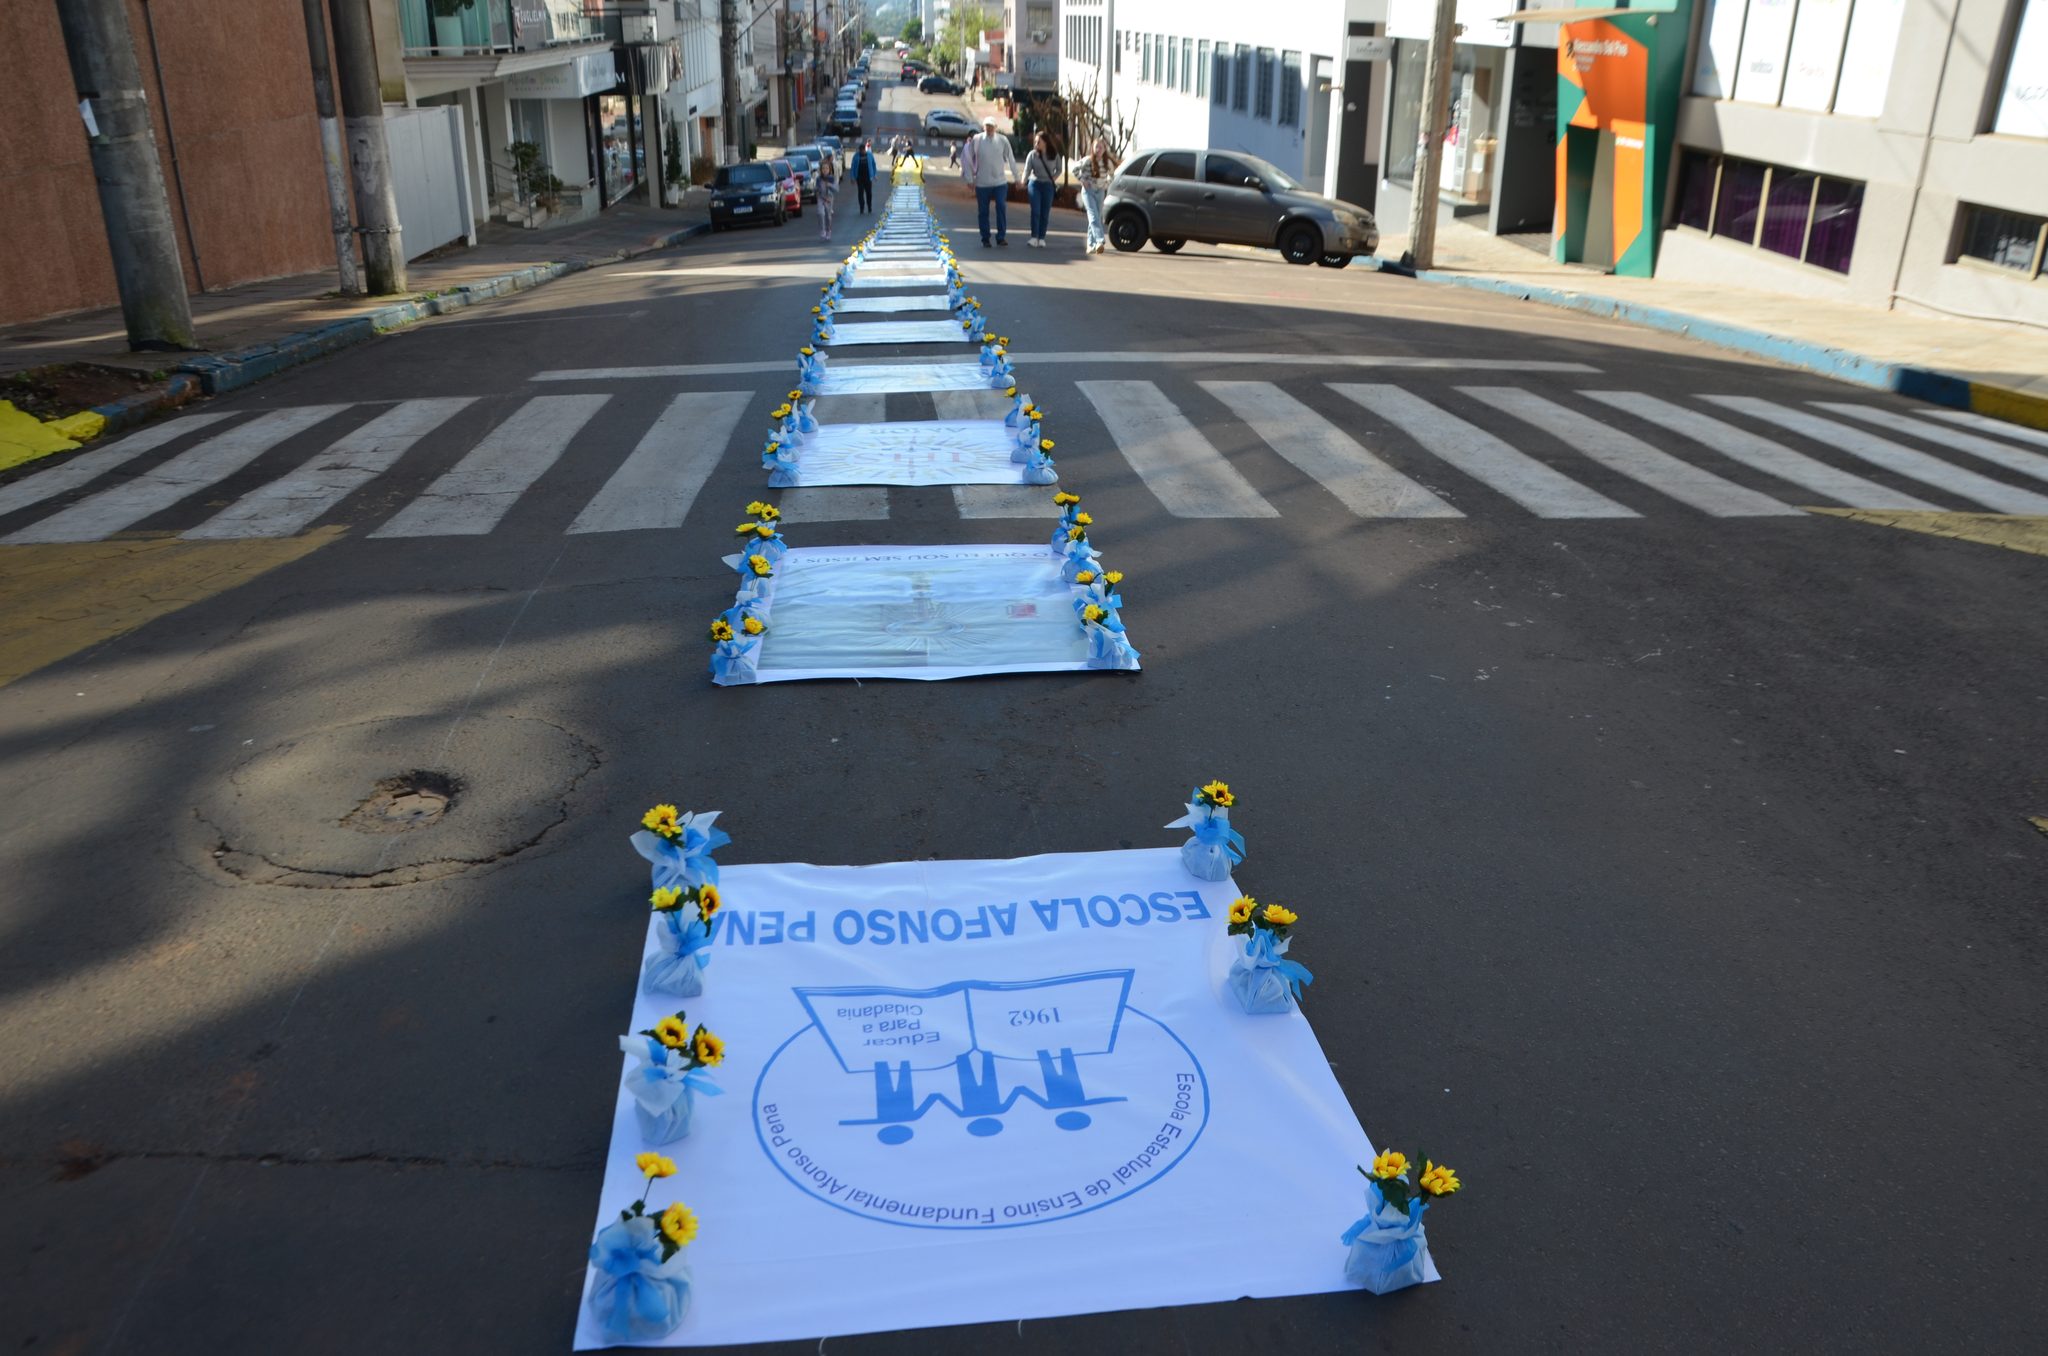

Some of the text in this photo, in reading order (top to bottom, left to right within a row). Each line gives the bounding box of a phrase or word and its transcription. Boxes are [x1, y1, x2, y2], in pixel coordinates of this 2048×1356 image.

[806, 555, 857, 564] JESUS
[864, 554, 902, 562] SEM
[1030, 890, 1213, 931] ESCOLA
[832, 902, 1018, 946] AFONSO
[836, 1003, 924, 1020] Cidadania
[1008, 1007, 1061, 1027] 1962
[862, 1018, 921, 1034] Para a
[863, 1031, 941, 1047] Educar
[762, 1072, 1196, 1225] Escola Estadual de Ensino Fundamental Afonso Pena
